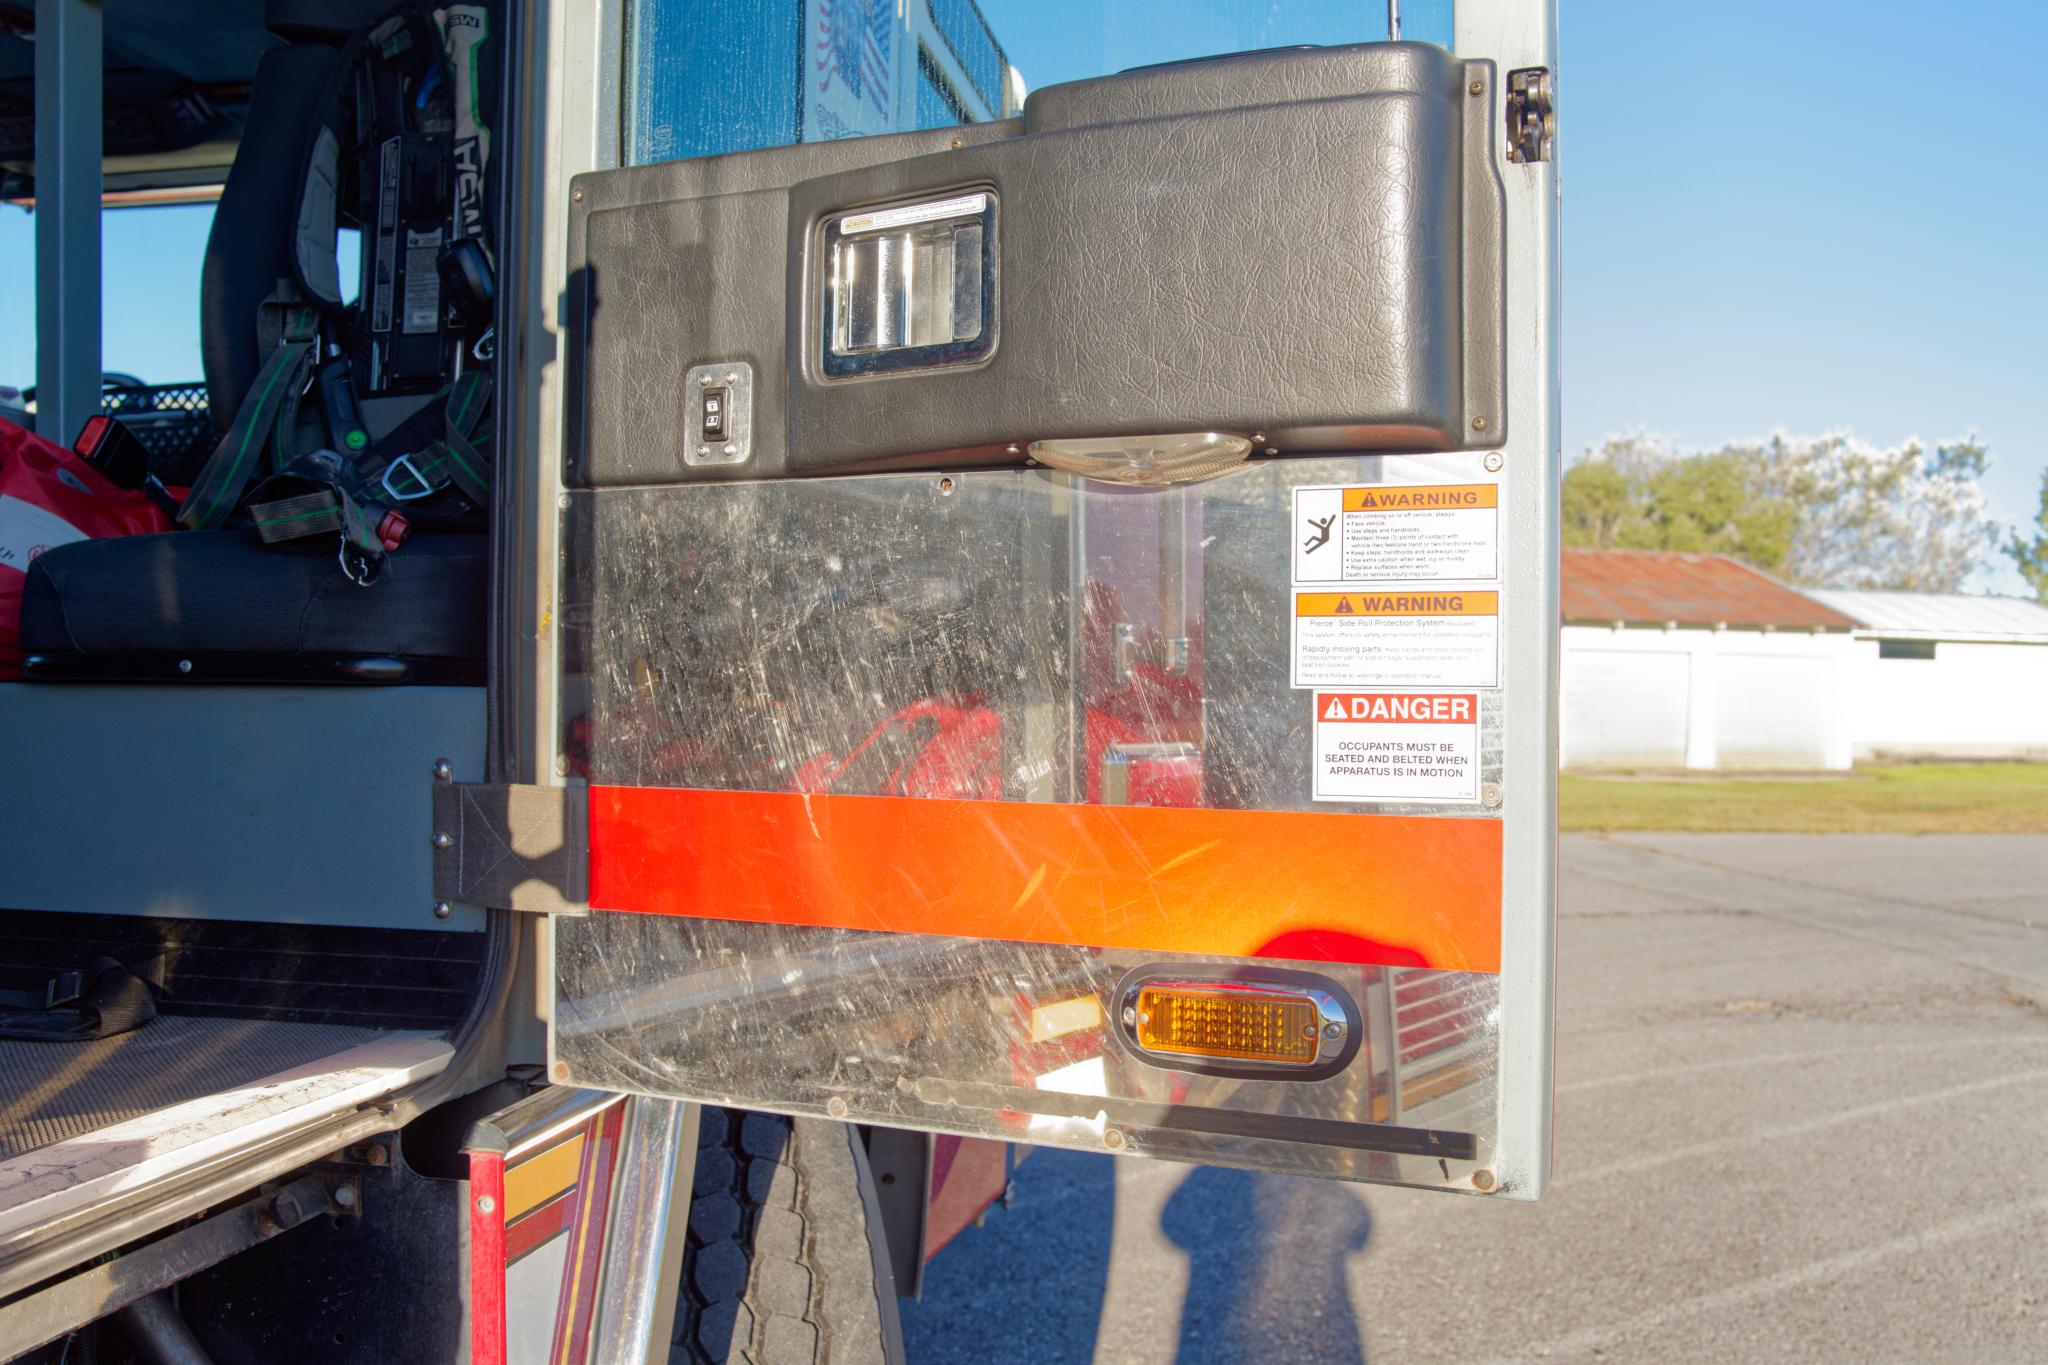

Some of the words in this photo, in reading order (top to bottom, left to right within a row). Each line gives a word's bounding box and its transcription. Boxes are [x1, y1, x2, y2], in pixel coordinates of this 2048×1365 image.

[1379, 492, 1477, 506] WARNING
[1363, 596, 1463, 611] WARNING
[1416, 619, 1446, 628] System
[1302, 645, 1330, 654] Rapidly
[1332, 646, 1360, 654] moving
[1352, 697, 1469, 719] DANGER
[1339, 742, 1403, 751] OCCUPANTS
[1407, 743, 1436, 752] MUST
[1440, 743, 1454, 752] BE
[1325, 754, 1364, 763] SEATED
[1367, 755, 1389, 764] AND
[1393, 755, 1433, 764] BELTED
[1436, 756, 1468, 765] WHEN
[1329, 766, 1390, 776] APPARATUS
[1394, 768, 1404, 776] IS
[1407, 768, 1417, 776] IN
[1420, 768, 1463, 777] MOTION
